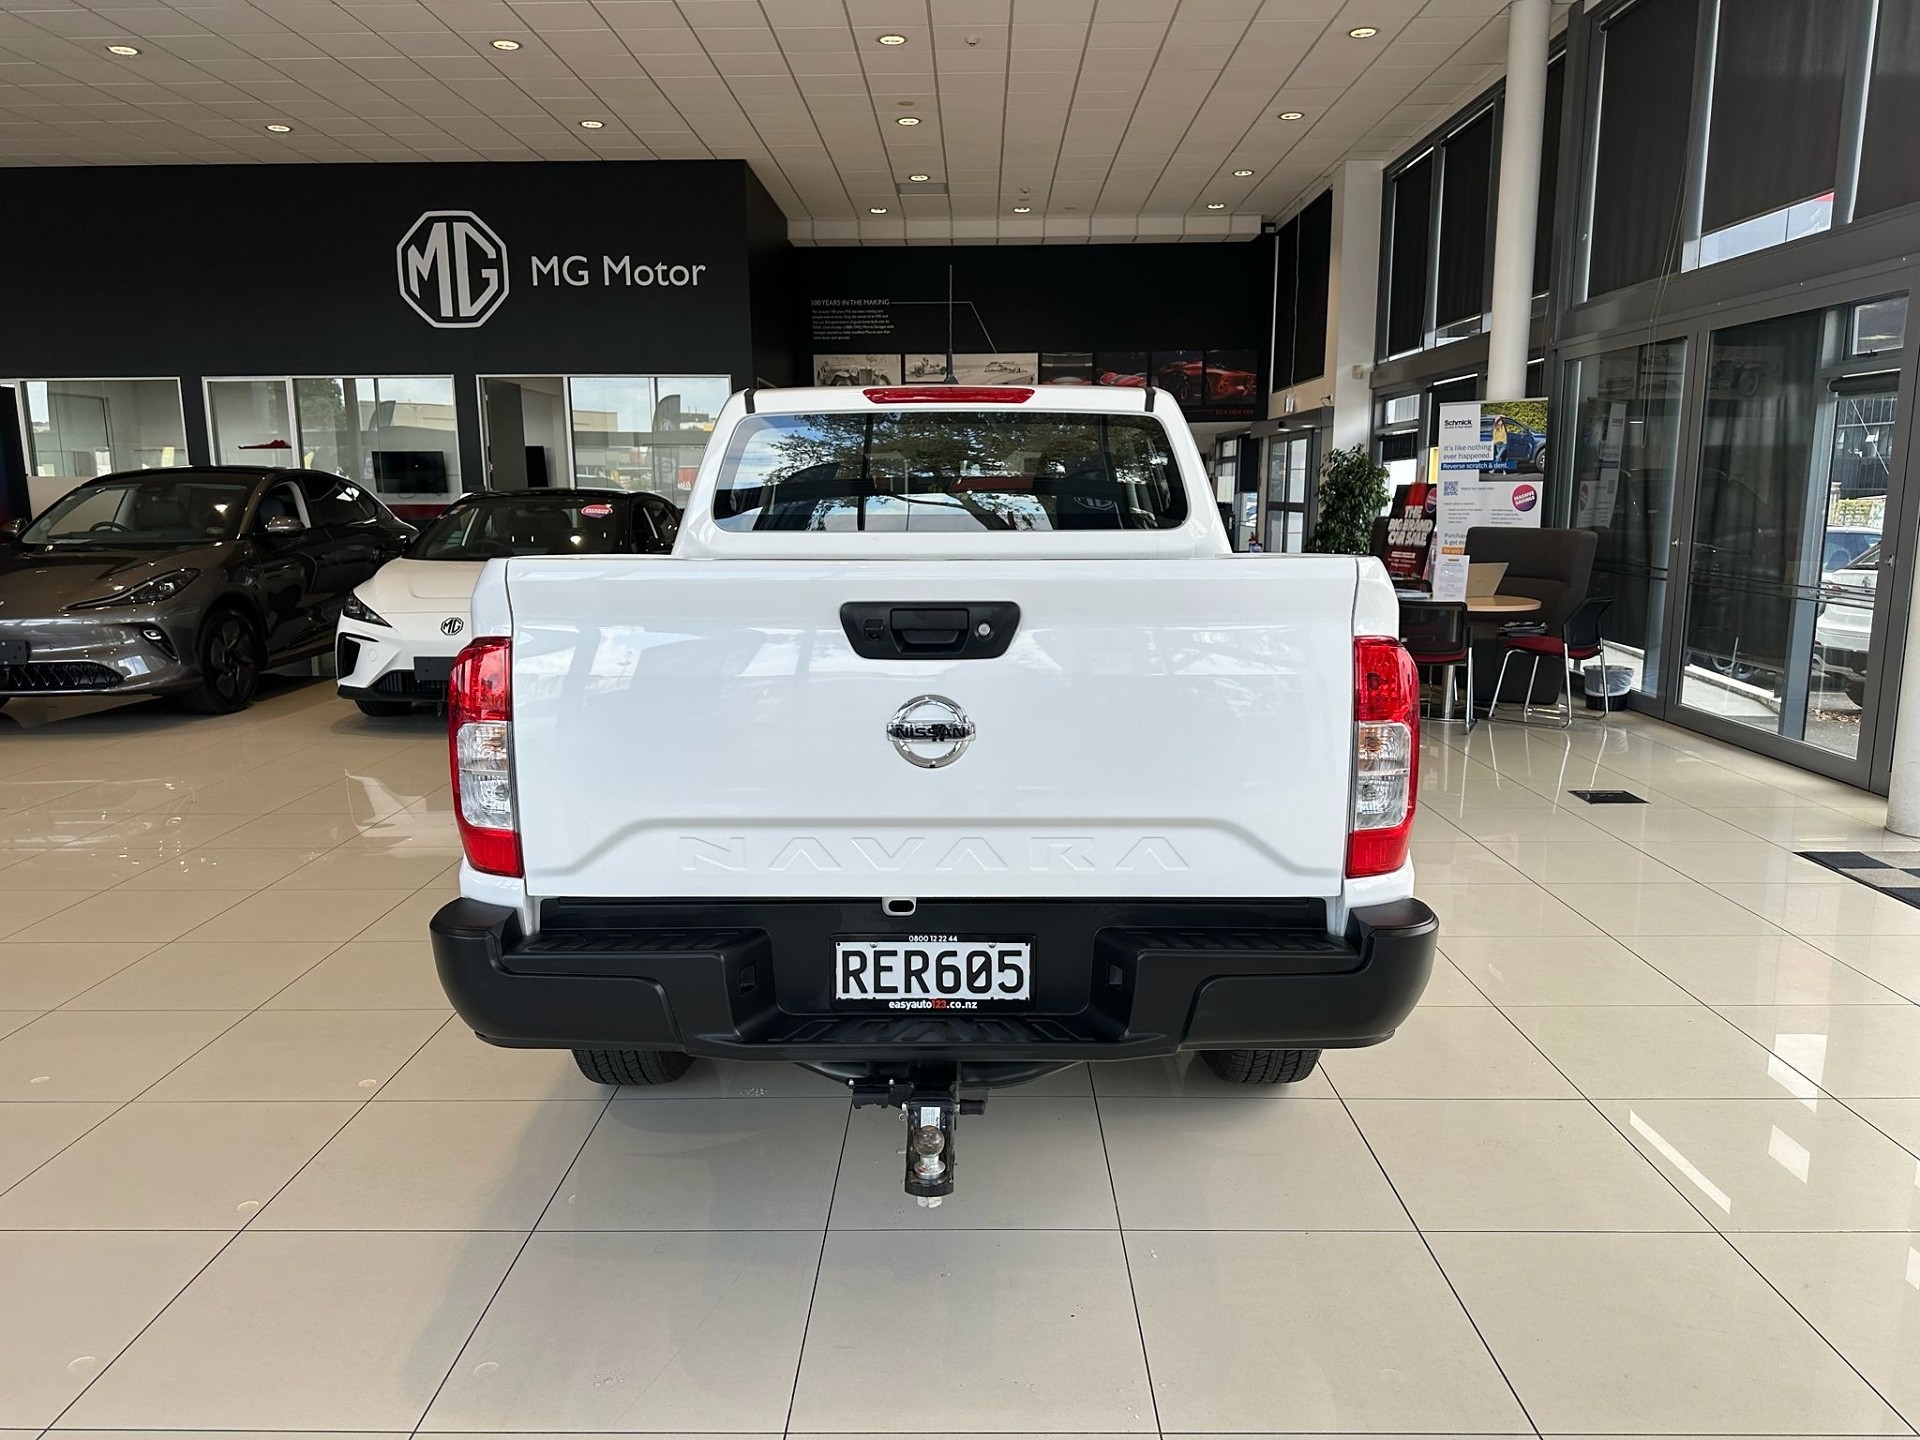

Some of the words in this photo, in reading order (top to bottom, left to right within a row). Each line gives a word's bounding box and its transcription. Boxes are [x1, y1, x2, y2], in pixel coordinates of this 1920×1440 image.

[407, 222, 498, 317] MG
[531, 255, 589, 286] MG
[603, 254, 706, 286] Motor
[863, 298, 890, 306] MAKING
[1467, 443, 1492, 452] nothing
[1458, 452, 1490, 461] happened.
[1404, 505, 1424, 519] THE
[1388, 518, 1403, 532] BIG
[1403, 519, 1433, 533] BRAND
[1388, 531, 1405, 546] CAR
[1405, 532, 1428, 547] SALE
[895, 725, 966, 738] NISSAN
[680, 836, 1189, 872] NAVARA
[841, 950, 1025, 994] RER605
[888, 1000, 978, 1011] easyauto123.co.nz
